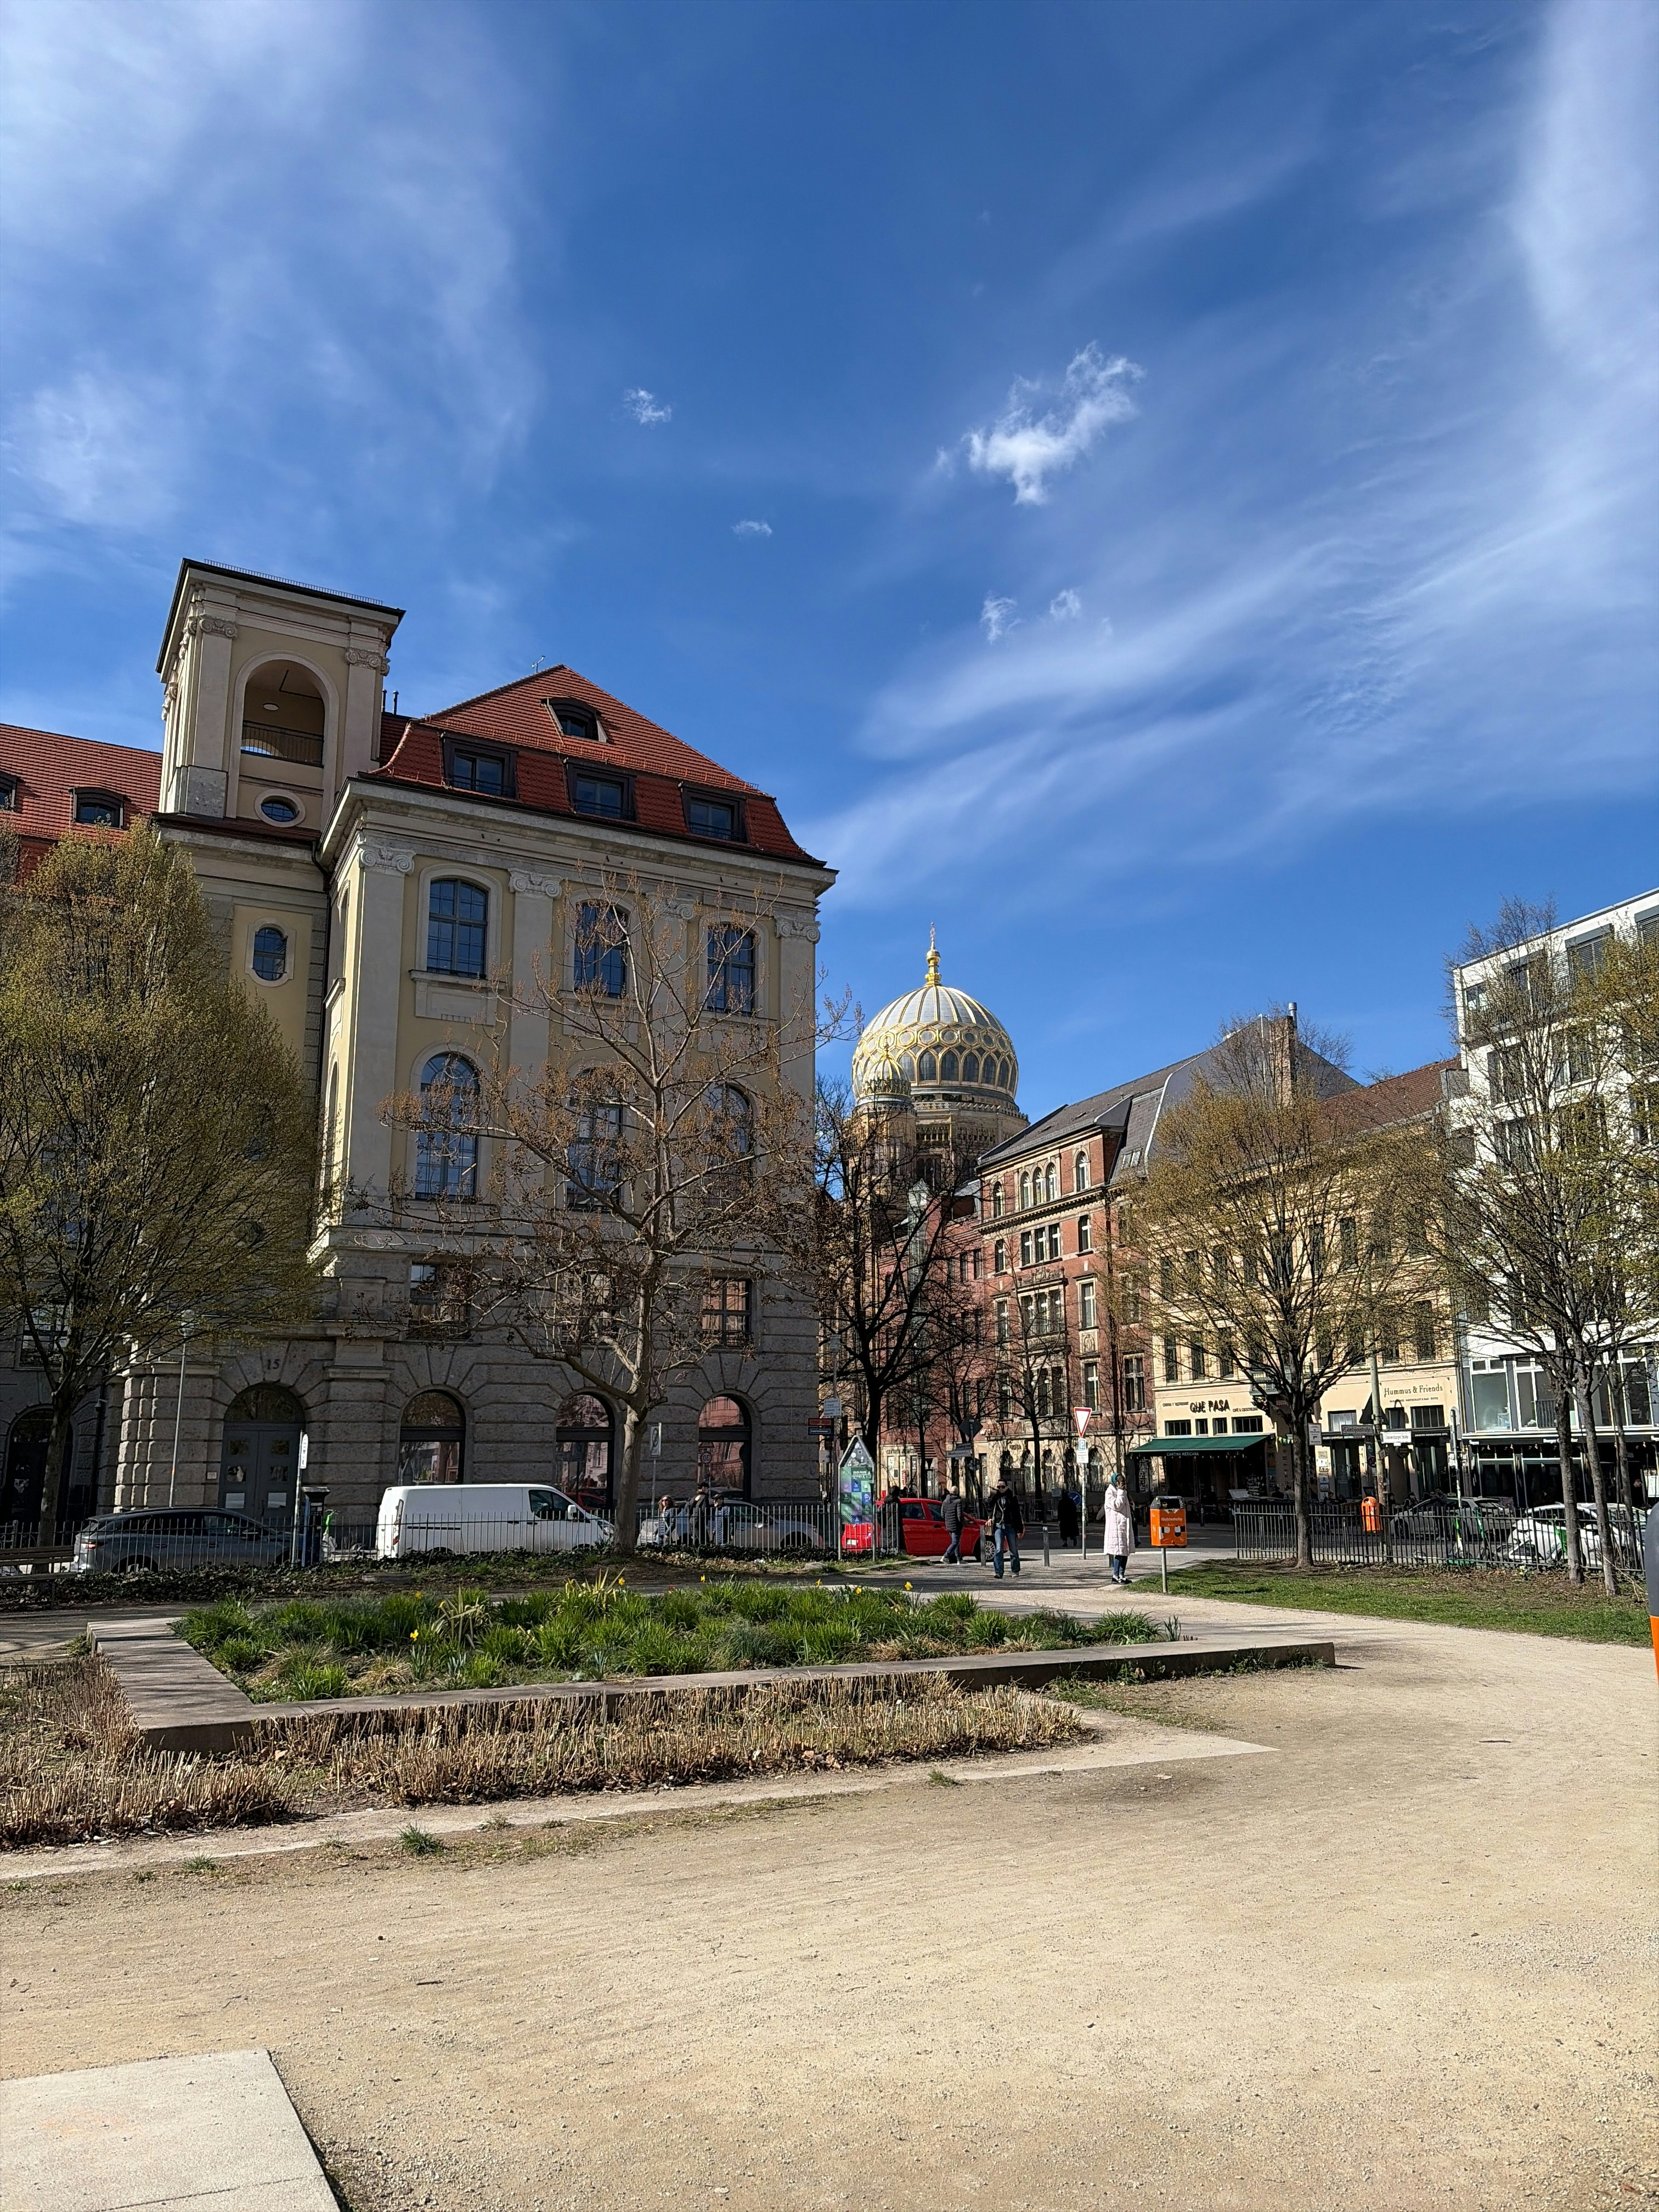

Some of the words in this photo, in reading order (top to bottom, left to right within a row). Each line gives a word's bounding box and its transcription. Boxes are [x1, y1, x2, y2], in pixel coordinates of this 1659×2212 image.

[266, 1359, 280, 1370] 15
[1419, 1383, 1443, 1393] Friends
[1190, 1401, 1206, 1413] QUE
[1208, 1400, 1231, 1413] PASA
